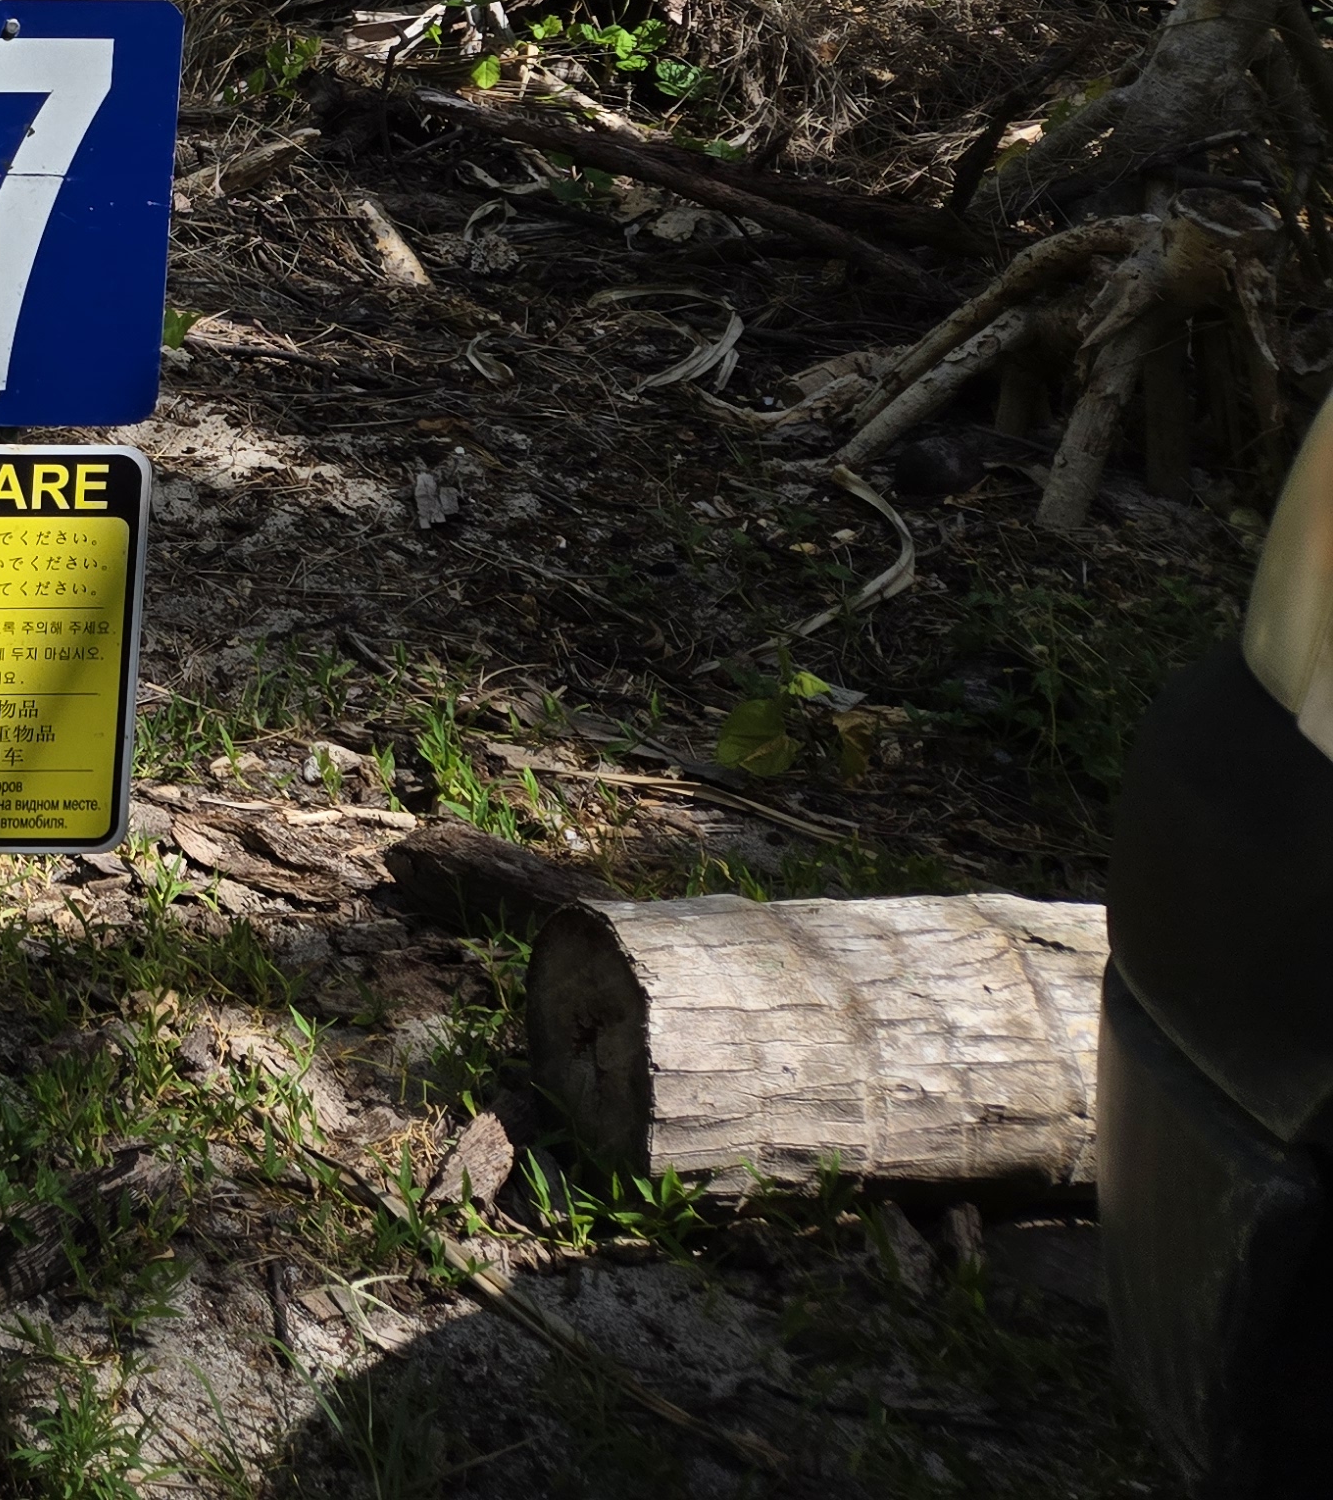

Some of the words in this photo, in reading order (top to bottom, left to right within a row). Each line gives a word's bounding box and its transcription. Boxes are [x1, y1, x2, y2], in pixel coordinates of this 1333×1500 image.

[21, 621, 62, 635] 주의해
[69, 621, 116, 635] 주세요.
[11, 647, 38, 661] 두지
[44, 647, 104, 661] 마십시오.
[15, 800, 59, 813] видном
[63, 800, 101, 811] месте.
